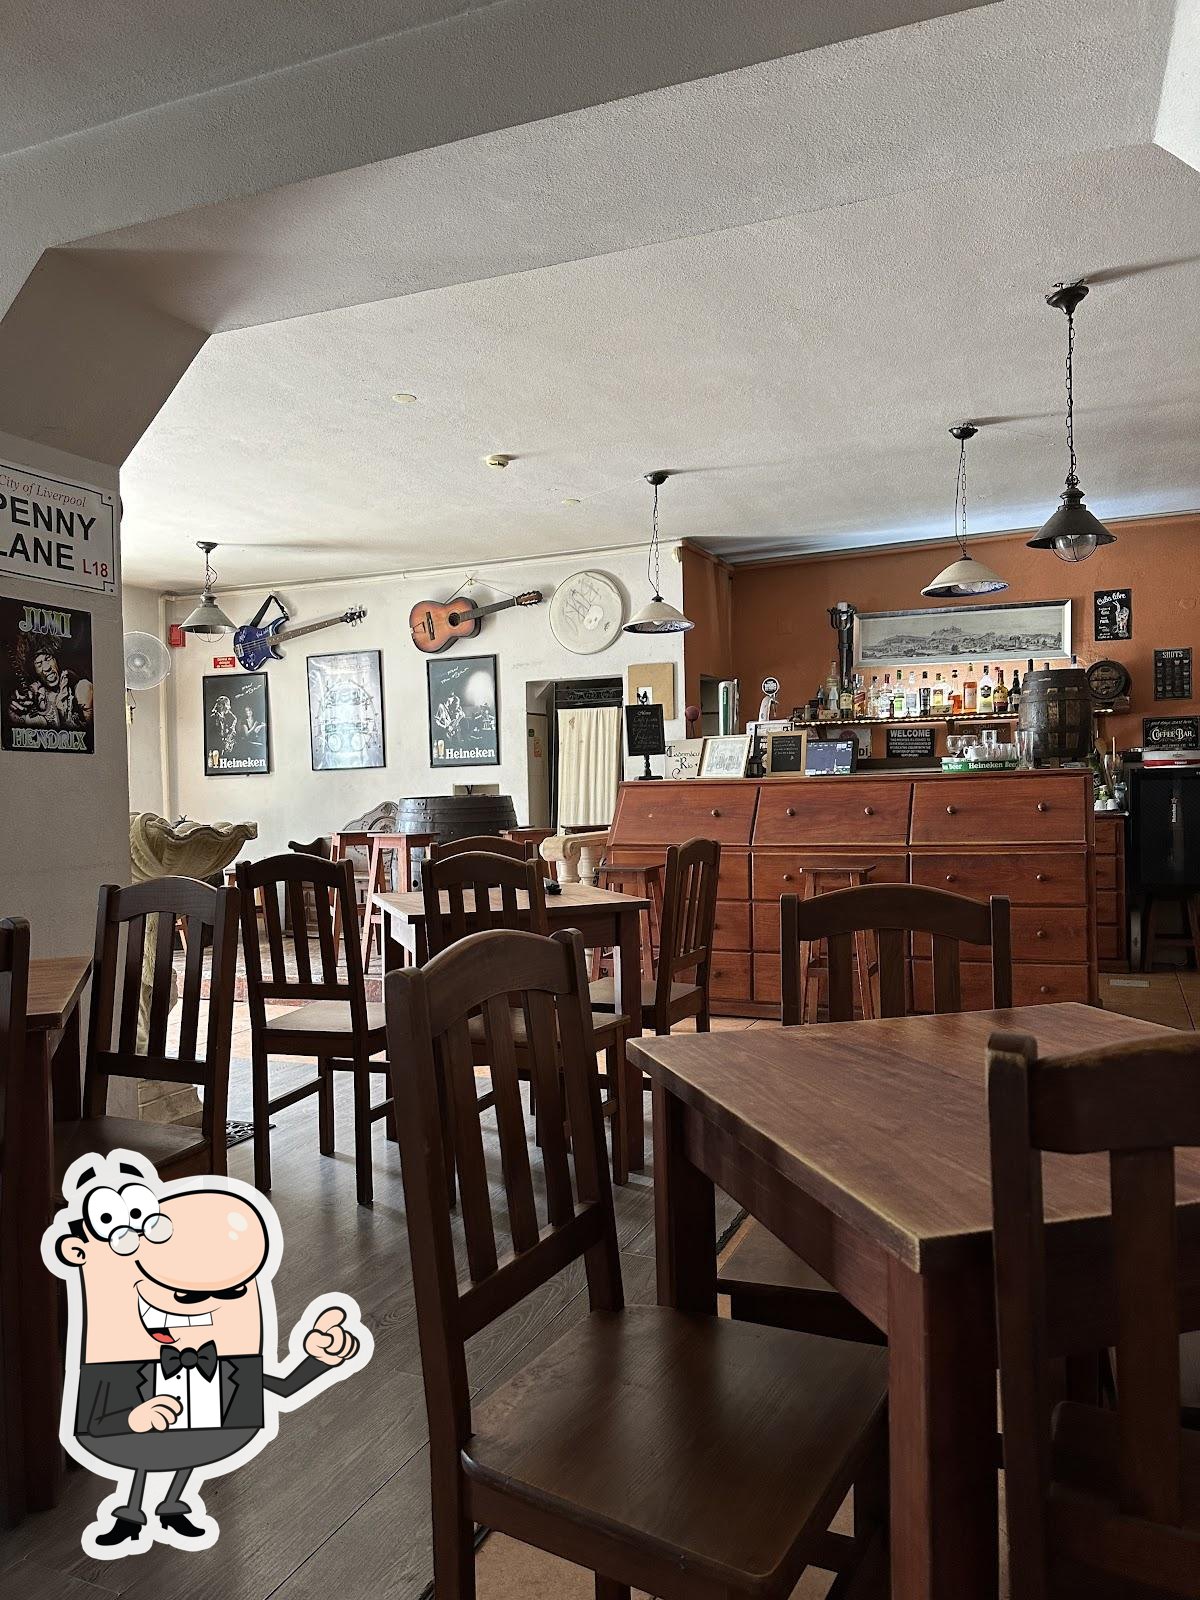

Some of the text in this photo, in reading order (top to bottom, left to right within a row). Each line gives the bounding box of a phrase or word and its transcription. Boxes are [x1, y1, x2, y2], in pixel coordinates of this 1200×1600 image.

[22, 482, 35, 497] of
[36, 484, 87, 508] Liverpool
[82, 558, 108, 578] L18
[18, 605, 72, 638] JIMI
[12, 727, 87, 751] HENDRIX
[890, 729, 931, 738] WELCOME
[445, 748, 496, 760] Heineken
[219, 757, 267, 769] Heineken
[968, 761, 1004, 770] Heineken
